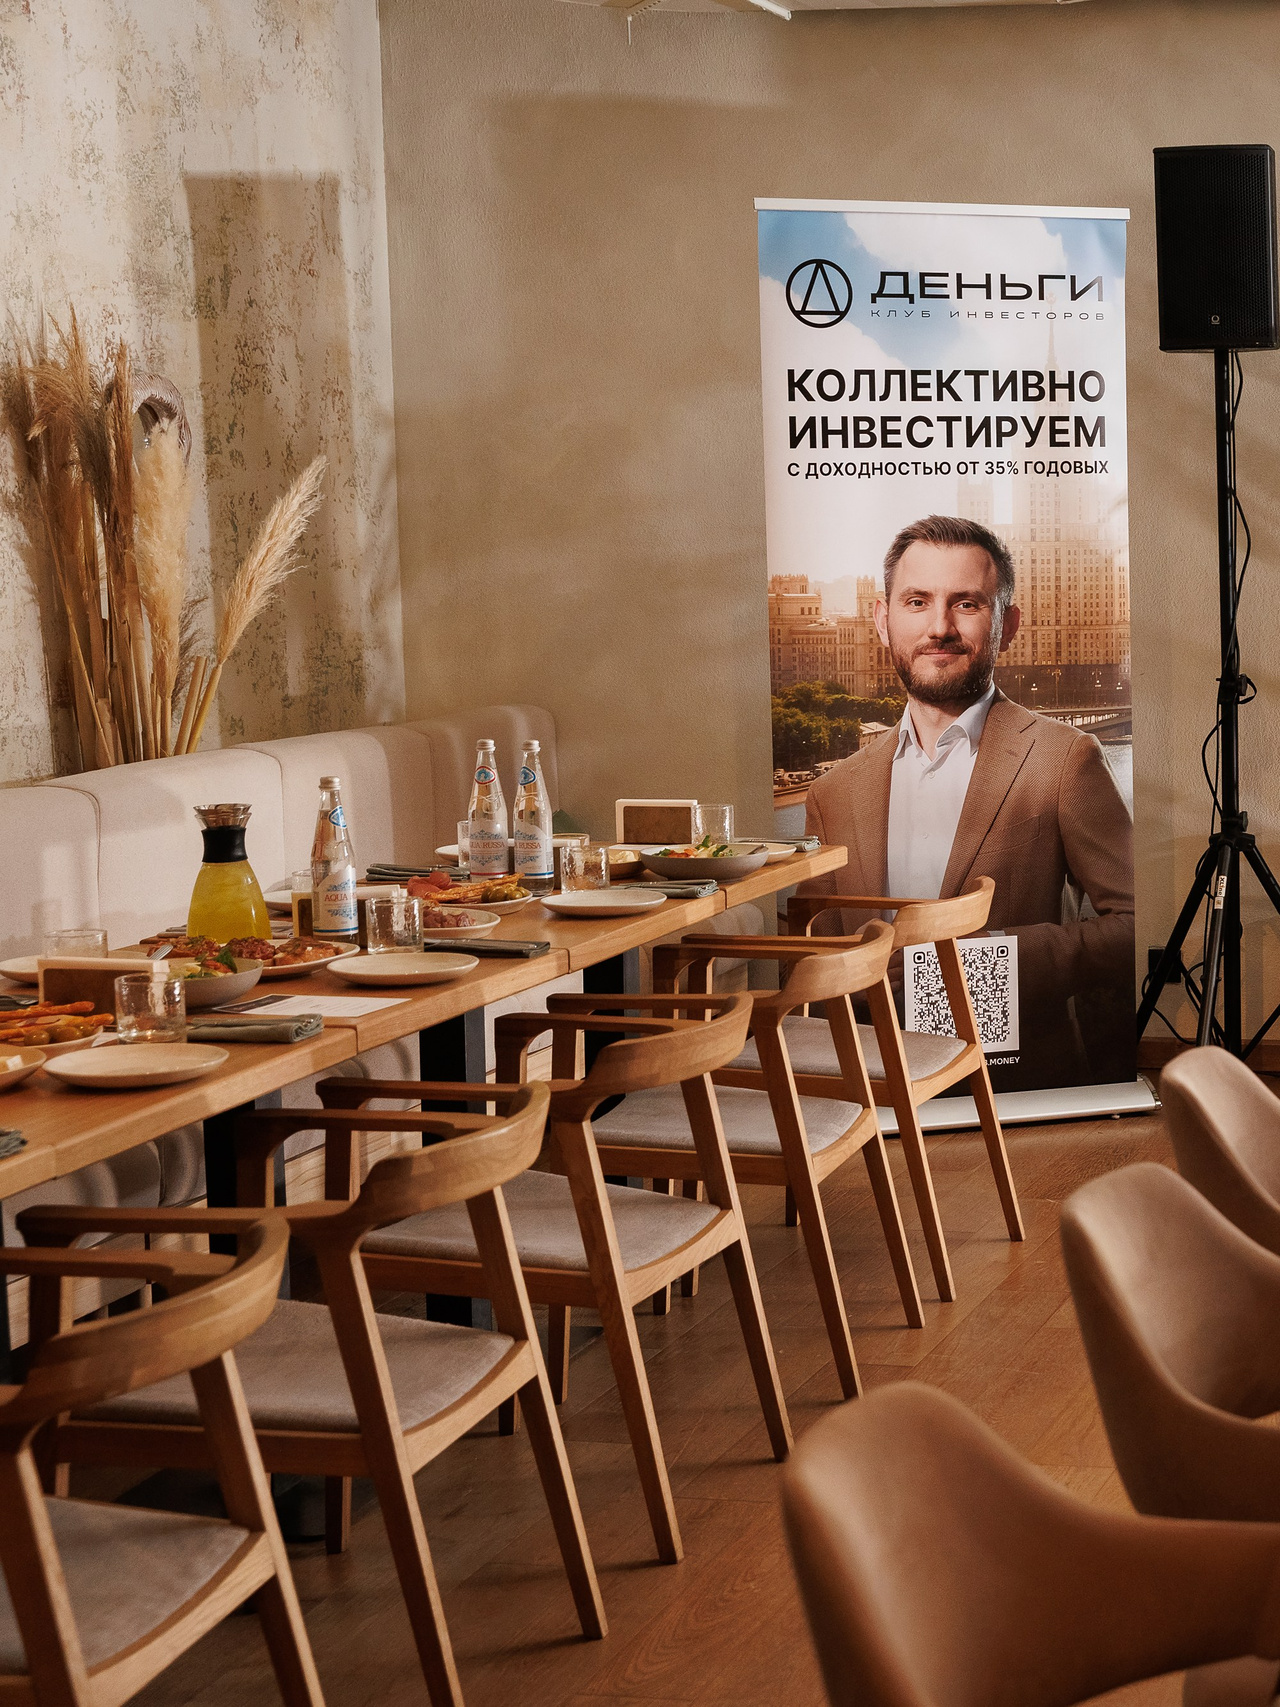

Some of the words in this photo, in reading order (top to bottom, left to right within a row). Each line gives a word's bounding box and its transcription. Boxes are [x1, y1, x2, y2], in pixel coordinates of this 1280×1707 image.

[871, 271, 1104, 304] ДЕНЬГИ
[871, 310, 931, 318] КЛУБ
[949, 310, 1104, 320] ИНВЕСТОРОВ
[787, 368, 1106, 402] КОЛЛЕКТИВНО
[788, 415, 1106, 449] ИНВЕСТИРУЕМ
[805, 461, 951, 479] ДОХОДНОСТЬЮ
[956, 461, 979, 475] ОТ
[984, 460, 1019, 475] 35%
[1024, 460, 1109, 477] ГОДОВЫХ
[324, 893, 348, 902] AQUA
